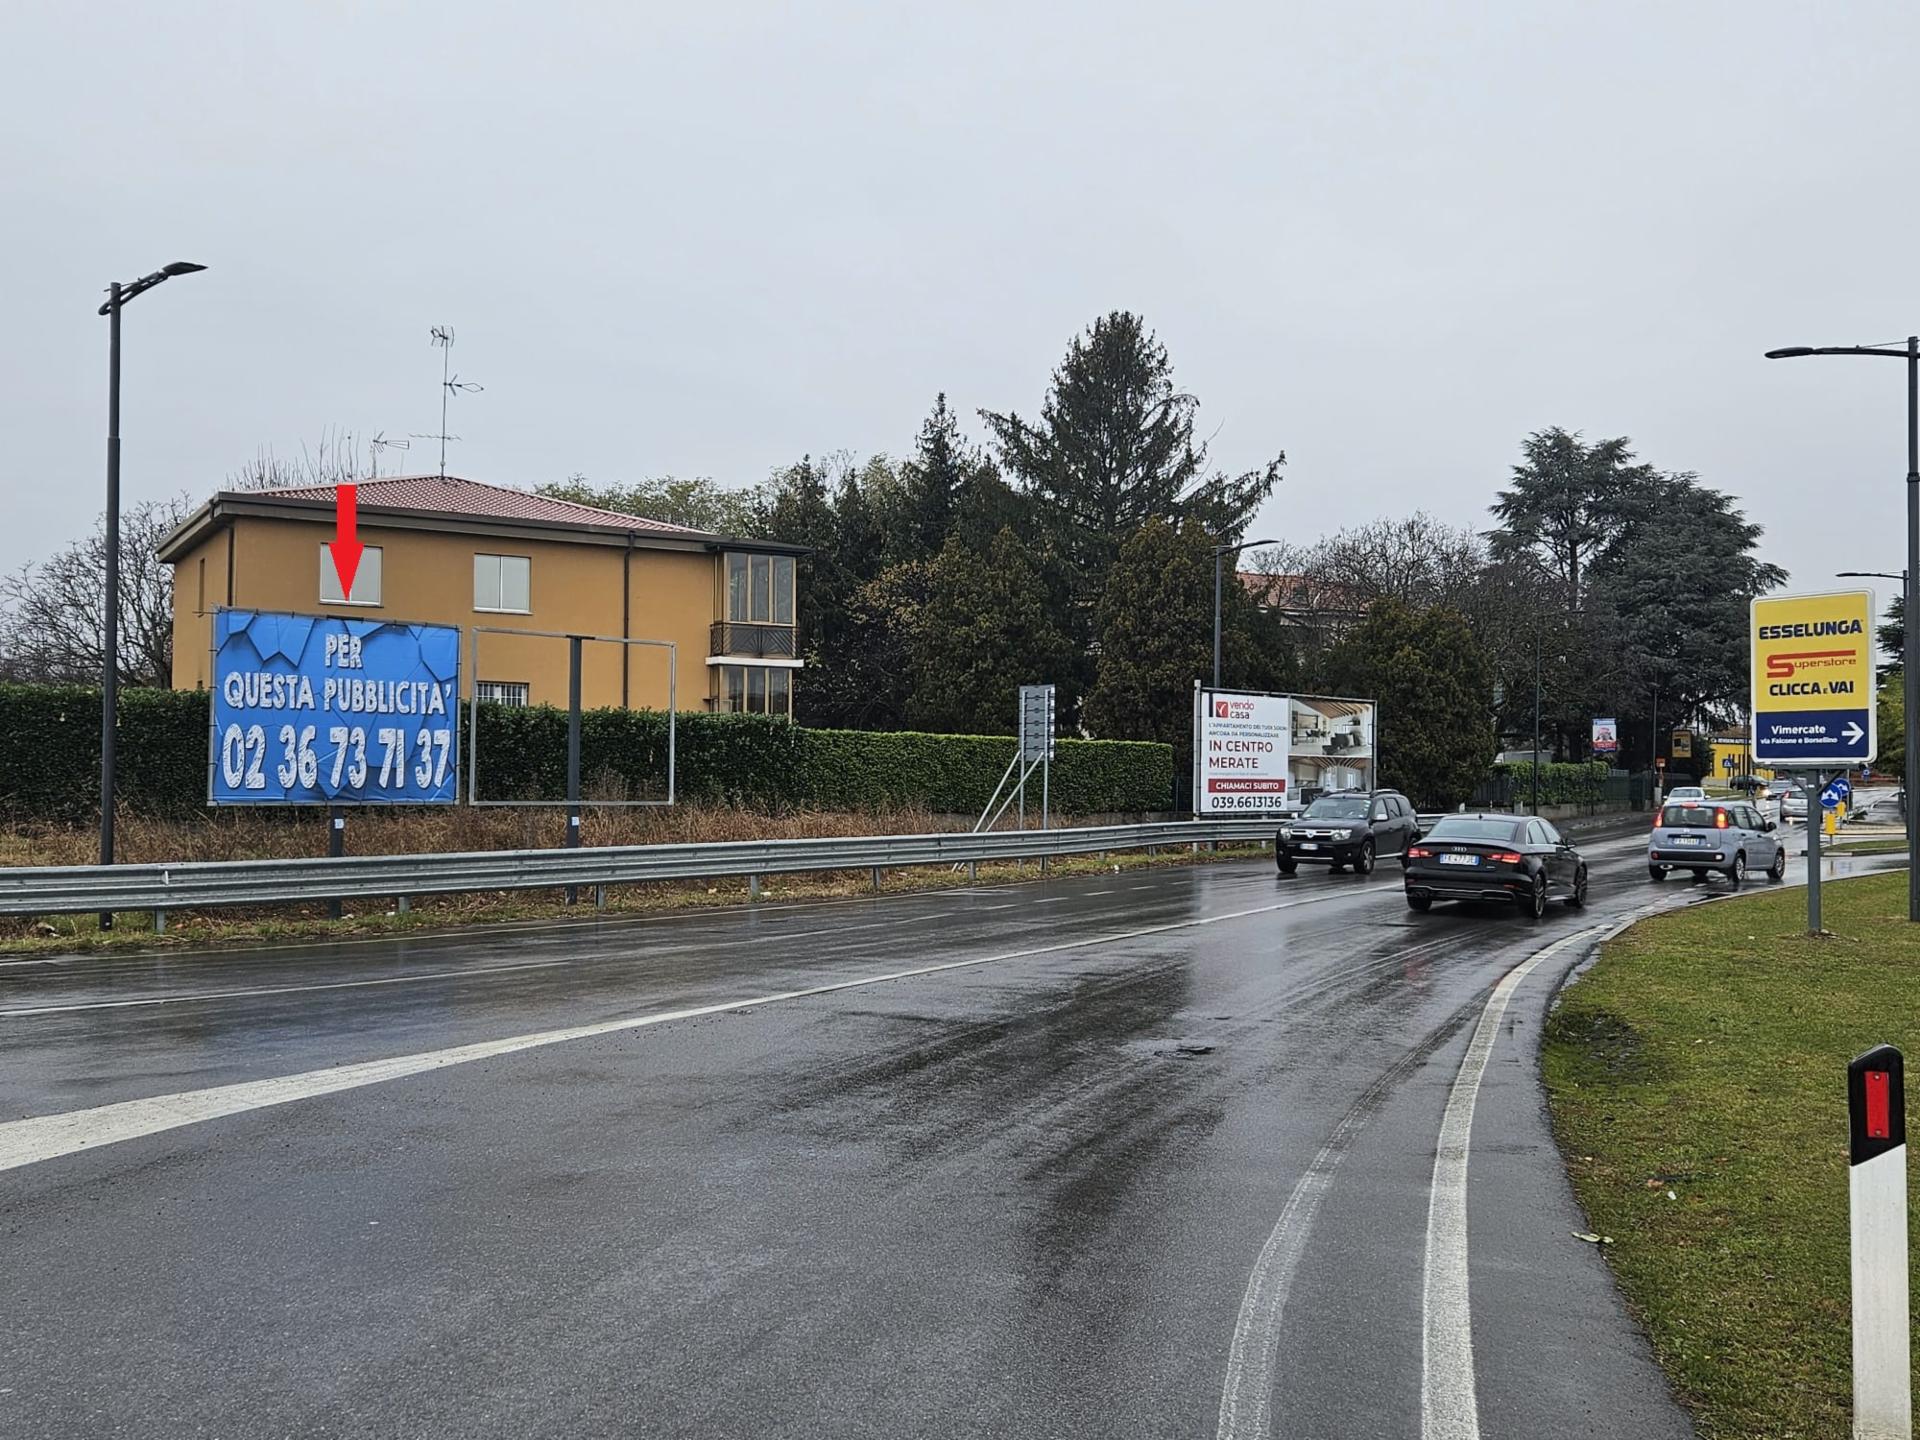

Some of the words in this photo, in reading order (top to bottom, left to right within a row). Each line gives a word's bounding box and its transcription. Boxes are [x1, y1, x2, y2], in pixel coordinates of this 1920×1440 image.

[1759, 619, 1862, 640] ESSELUNGA
[325, 633, 363, 669] PER
[1766, 650, 1857, 679] Superstore
[224, 671, 315, 709] QUESTA
[324, 677, 452, 715] PUBBLICITA'
[1769, 682, 1822, 696] CLICCA
[1829, 681, 1854, 694] VAI
[1230, 699, 1255, 711] vendo
[1230, 711, 1250, 720] casa
[1771, 725, 1826, 735] Vimercate
[1209, 740, 1222, 751] IN
[1226, 740, 1273, 753] CENTRO
[223, 723, 266, 789] 02
[277, 724, 318, 790] 36
[329, 726, 368, 789] 73
[378, 728, 405, 789] 71
[415, 728, 450, 789] 37
[1209, 756, 1259, 768] MERATE
[1215, 782, 1252, 790] CHIAMACI
[1253, 782, 1279, 790] SUBITO
[1211, 796, 1282, 809] 039.6613136
